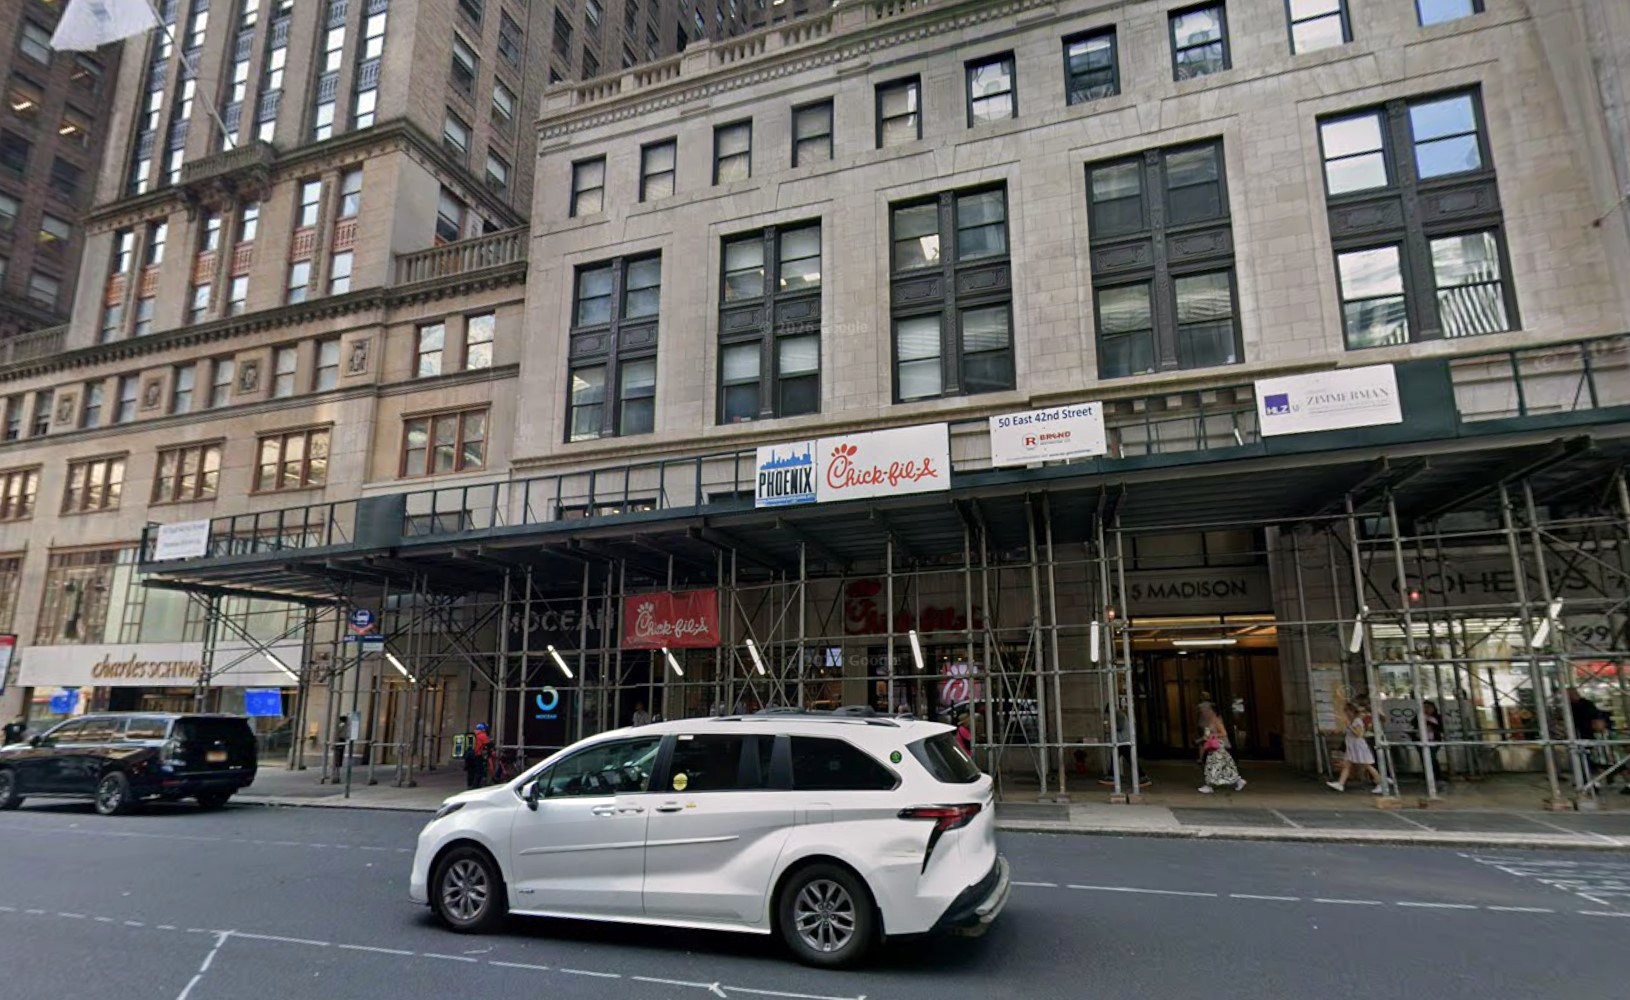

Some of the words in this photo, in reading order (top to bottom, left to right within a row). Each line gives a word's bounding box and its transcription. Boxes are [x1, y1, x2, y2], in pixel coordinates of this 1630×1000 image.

[998, 417, 1010, 428] 50
[1013, 415, 1032, 425] East
[1034, 410, 1060, 422] 42nd
[1062, 407, 1093, 419] Street
[759, 466, 813, 498] PHOENIX
[827, 454, 939, 489] Chick-fil-A
[1147, 579, 1248, 599] MADISON
[635, 611, 709, 638] Chick-fil-A
[92, 653, 146, 679] charles
